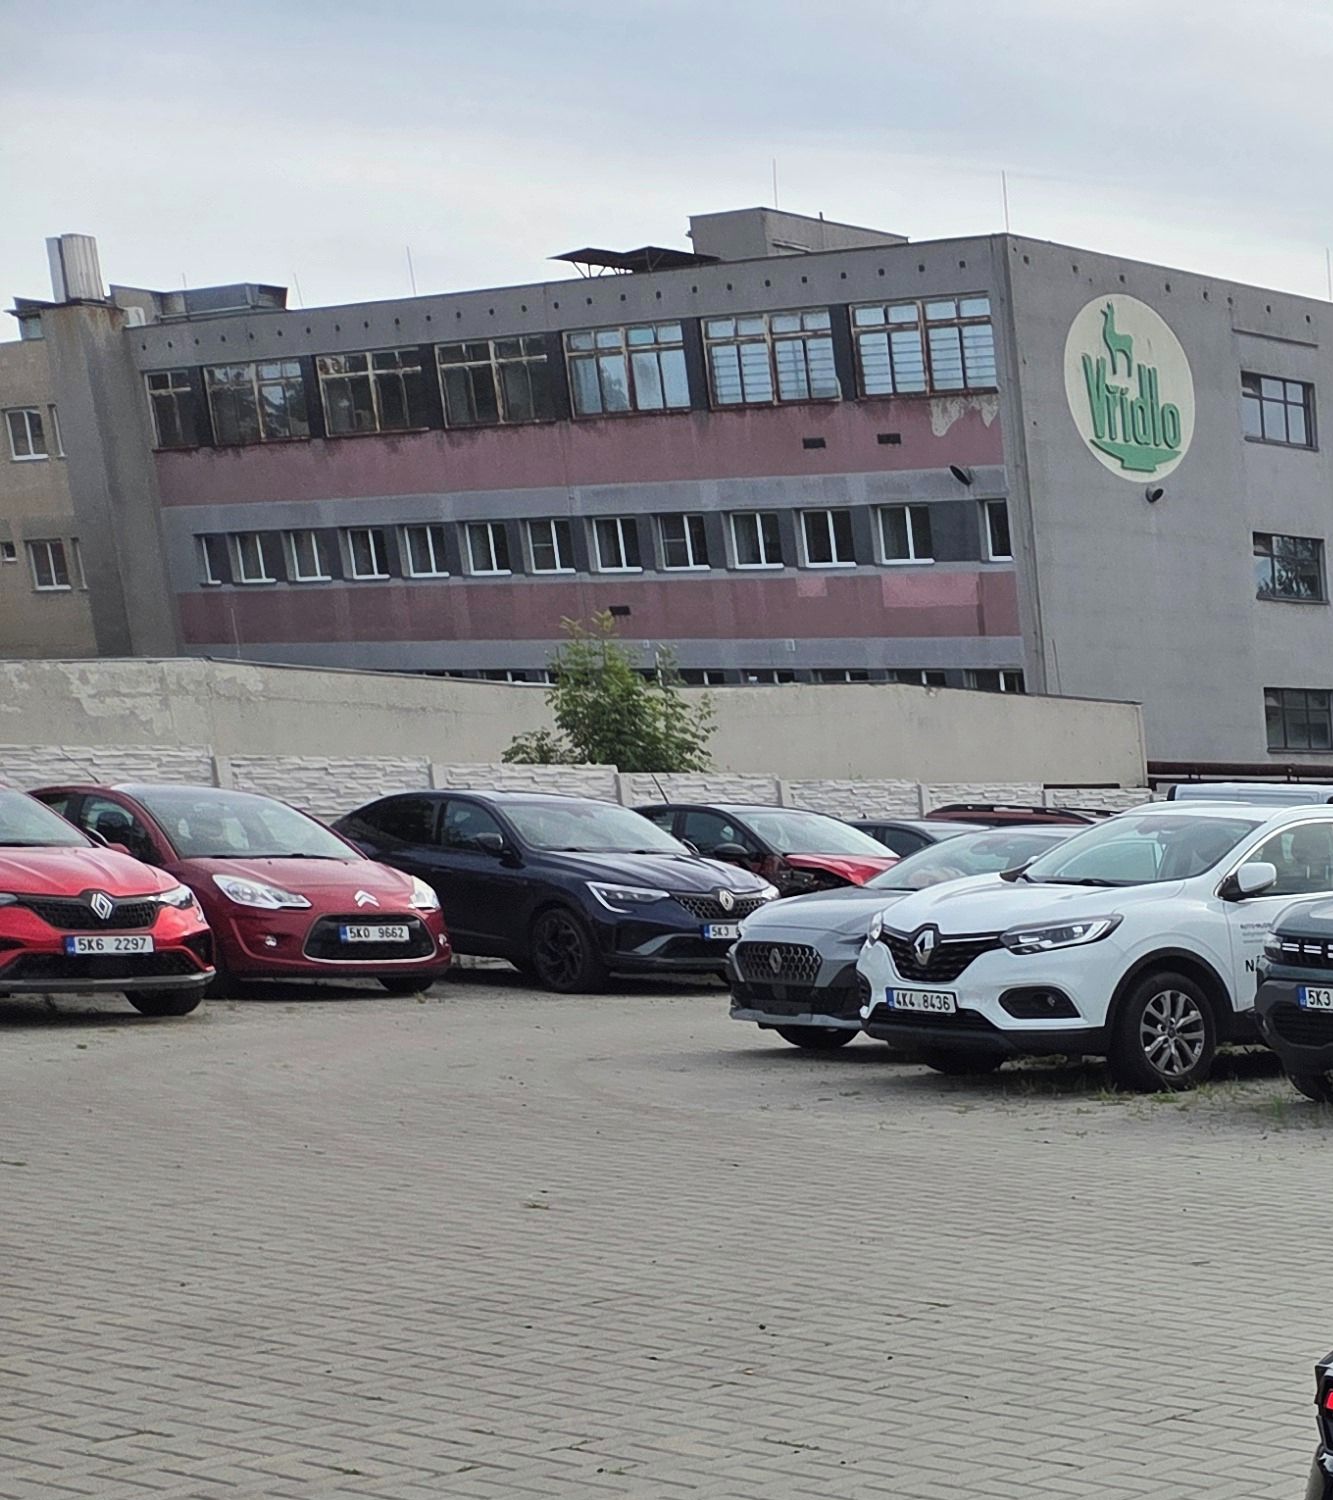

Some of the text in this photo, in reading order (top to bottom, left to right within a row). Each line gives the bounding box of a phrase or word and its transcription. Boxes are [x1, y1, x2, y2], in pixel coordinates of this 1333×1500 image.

[78, 938, 105, 952] 5K6
[114, 937, 147, 951] 2297
[896, 992, 951, 1011] 4K4 8436
[1308, 989, 1331, 1007] 5K3
